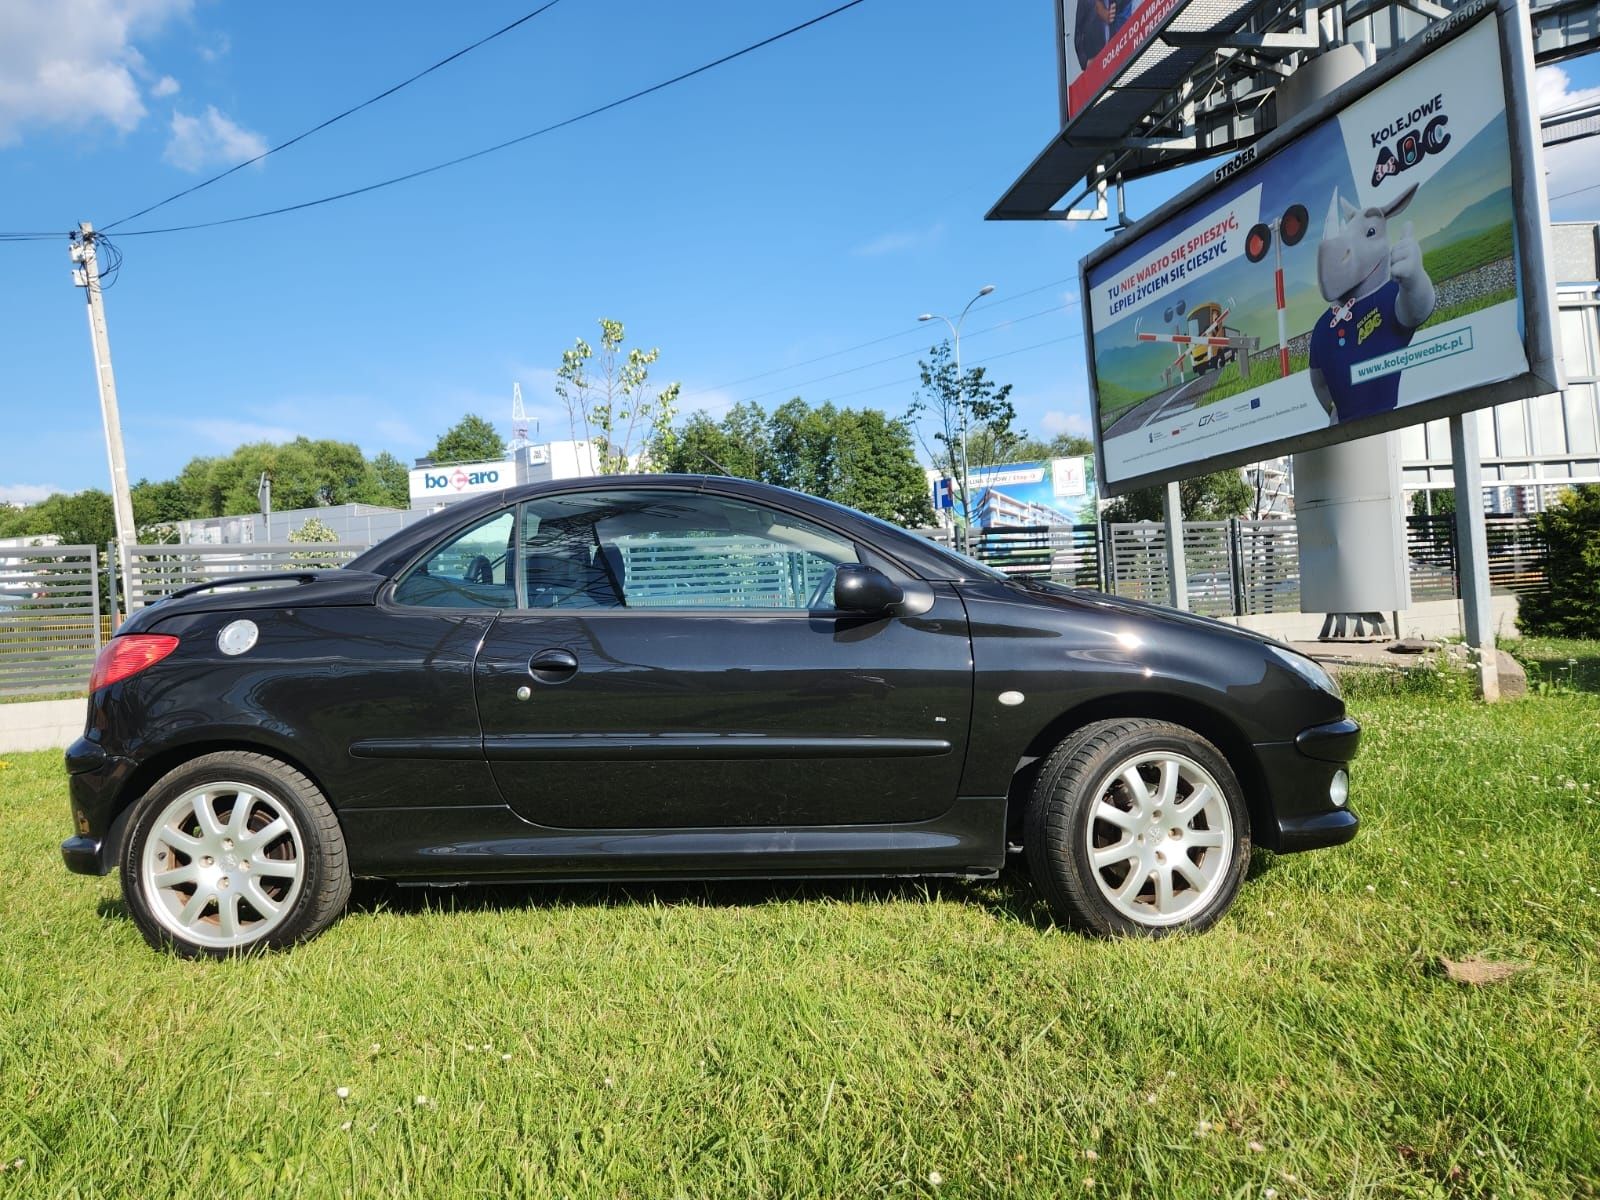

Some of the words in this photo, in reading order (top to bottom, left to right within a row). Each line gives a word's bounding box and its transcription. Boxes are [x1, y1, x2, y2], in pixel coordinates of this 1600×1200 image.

[1102, 33, 1128, 69] DOŁĄCZ
[1129, 20, 1139, 39] DO
[1133, 35, 1144, 51] NA
[1371, 94, 1443, 148] KOLEJOWE
[1215, 147, 1256, 183] STRÖER
[1371, 115, 1451, 187] ABC
[1108, 284, 1120, 300] TU
[1120, 275, 1136, 293] NIE
[1136, 256, 1170, 283] WARTO
[1171, 245, 1186, 263] SIĘ
[1187, 211, 1239, 253] SPIESZYĆ,
[1110, 292, 1136, 316] LEPIEJ
[1136, 272, 1169, 301] ŻYCIEM
[1170, 264, 1186, 282] SIĘ
[1186, 235, 1228, 272] CIESZYĆ
[1358, 335, 1463, 377] www.kolejoweabc.pl
